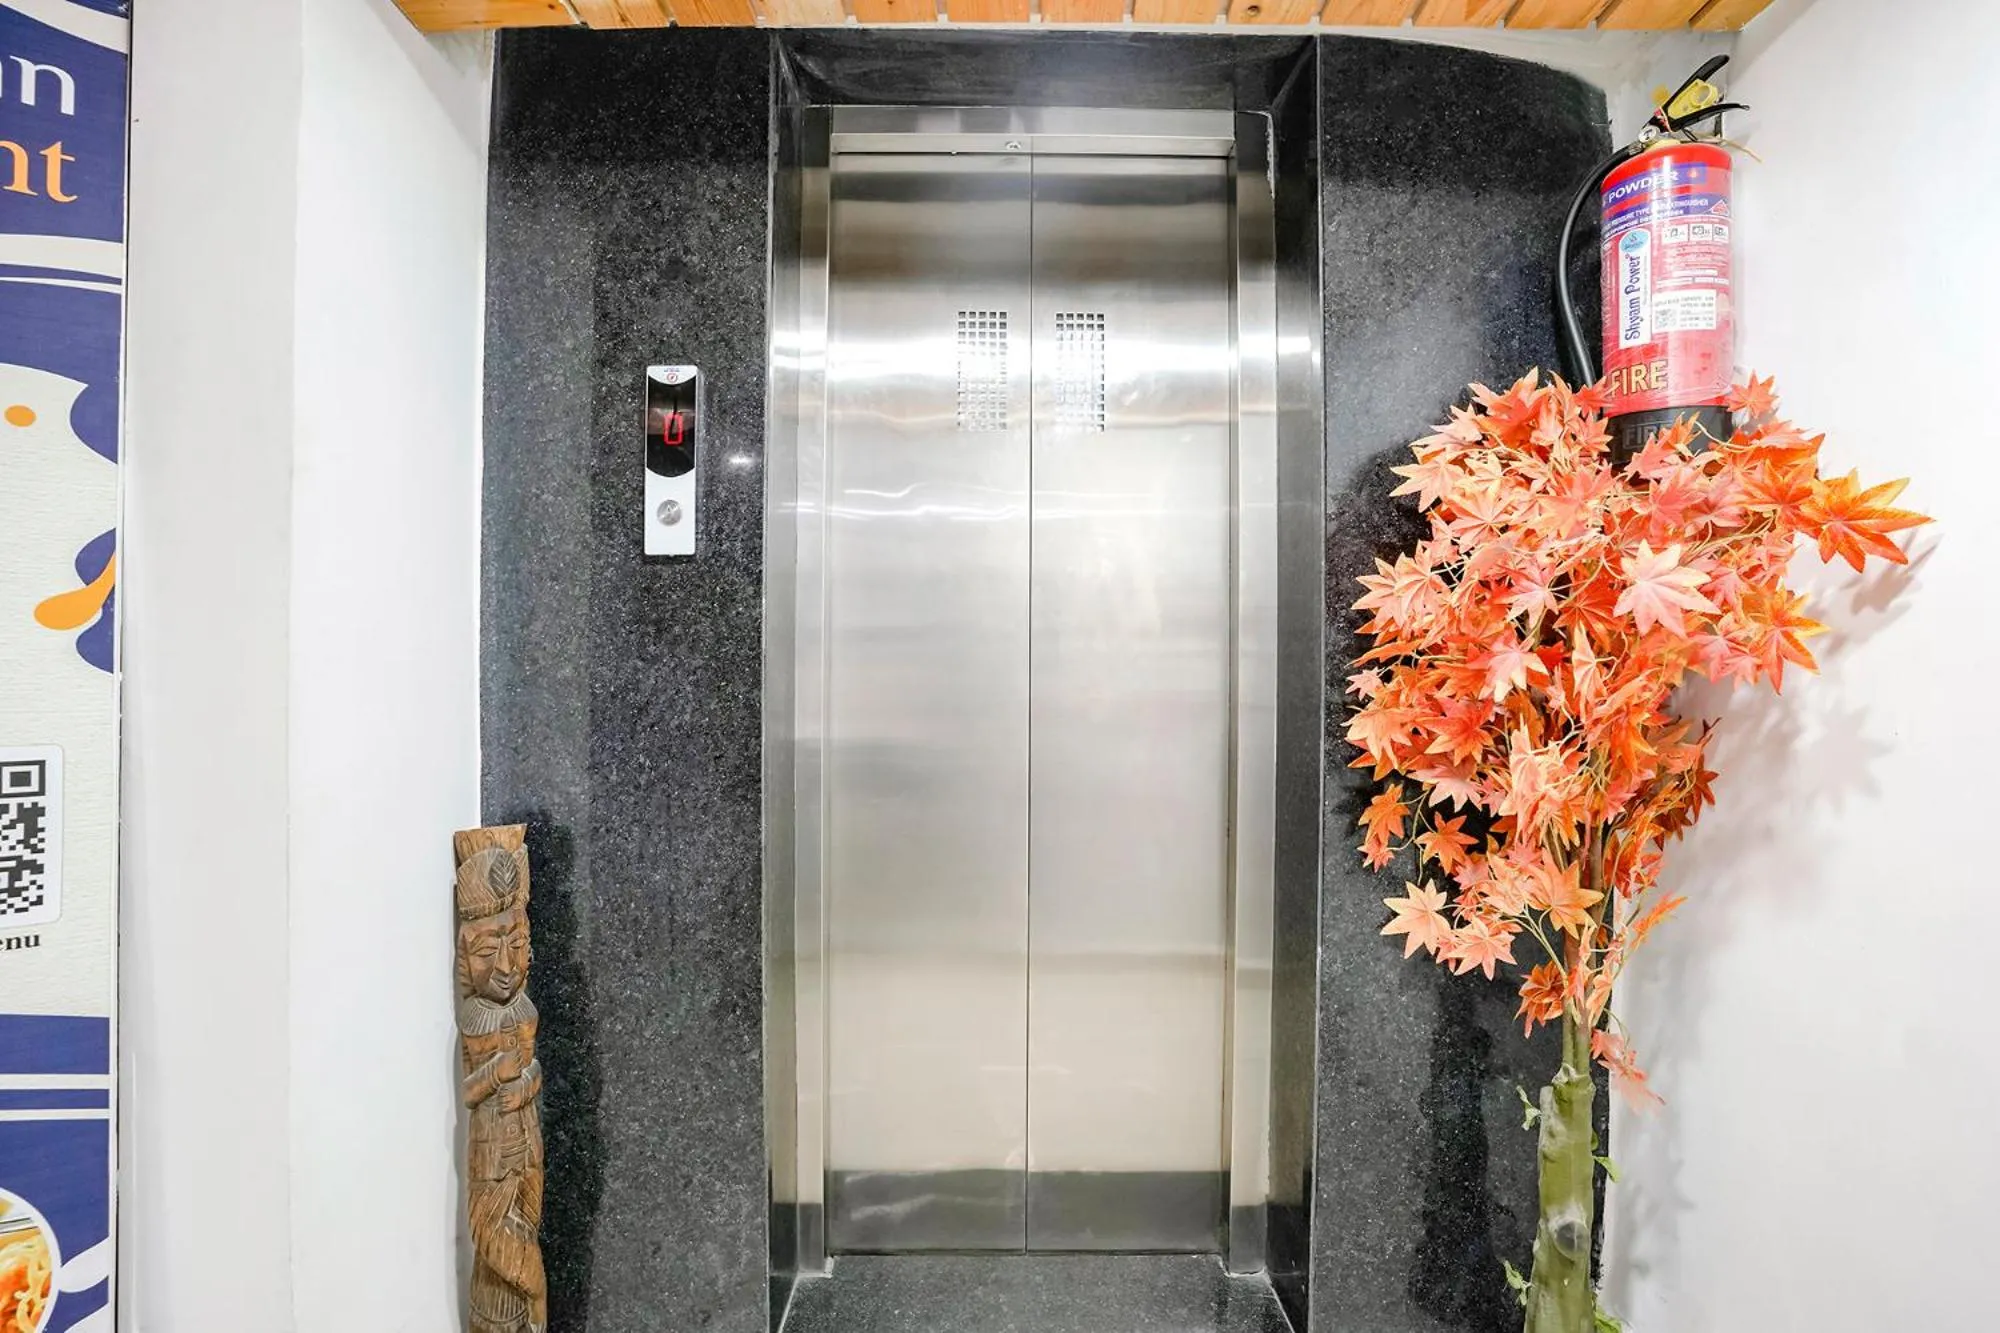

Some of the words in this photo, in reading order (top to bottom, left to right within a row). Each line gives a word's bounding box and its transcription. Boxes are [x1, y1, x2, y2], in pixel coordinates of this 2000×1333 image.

[0, 54, 75, 116] n
[1625, 255, 1641, 296] Power
[1625, 296, 1644, 341] Shyam
[1611, 359, 1669, 398] FIRE
